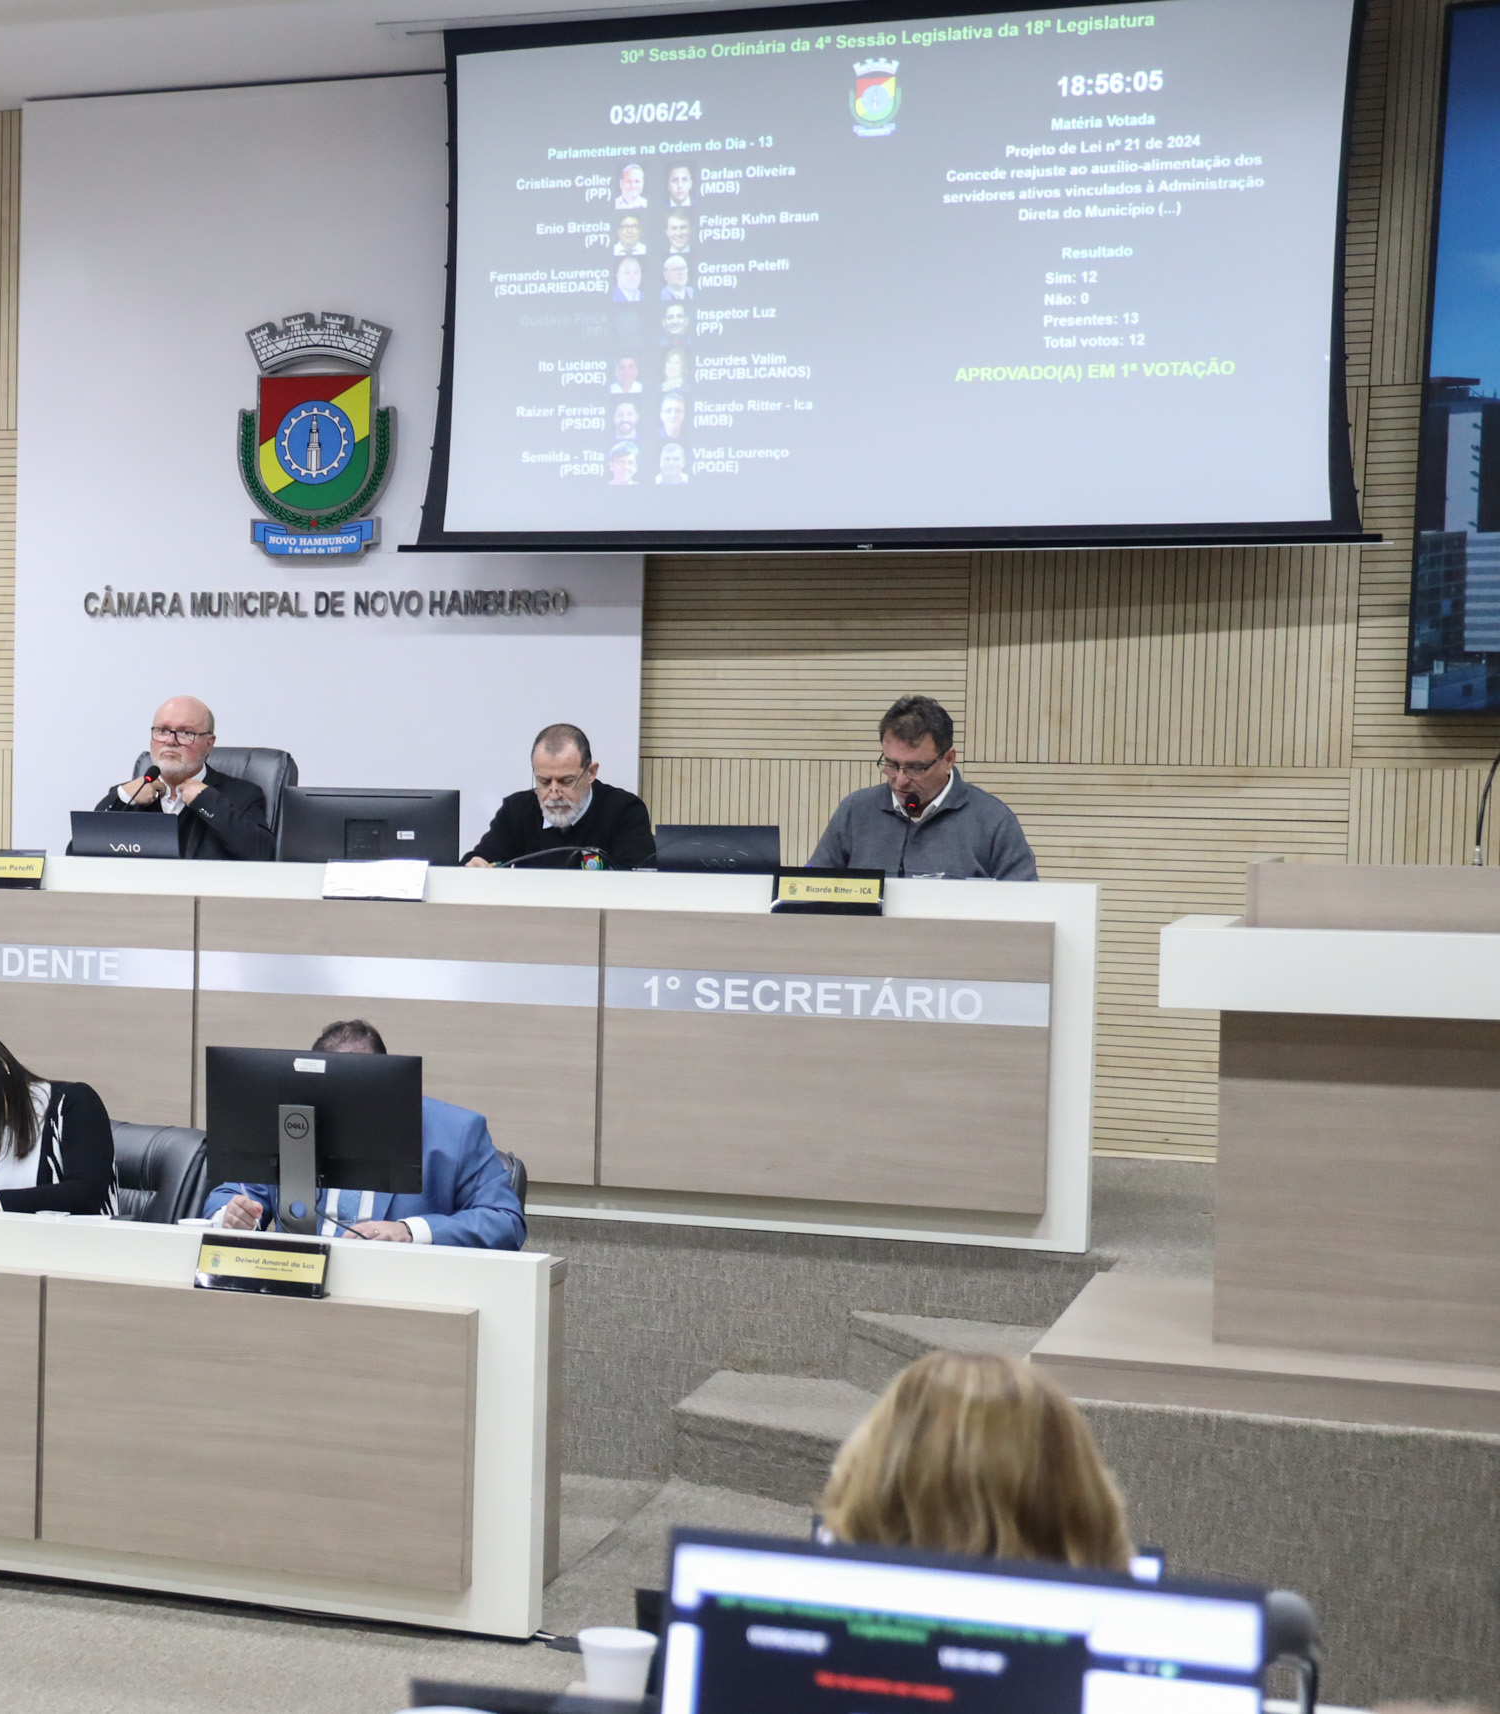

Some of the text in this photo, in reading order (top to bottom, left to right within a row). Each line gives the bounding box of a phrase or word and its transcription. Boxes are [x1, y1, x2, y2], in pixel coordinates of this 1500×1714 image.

[620, 15, 1155, 64] 30ª Sessão Ordinária da 4ª Sessão Legislativa da 18ª Legislatura
[1057, 70, 1164, 97] 18:56:05
[609, 100, 702, 125] 03/06/24
[1051, 113, 1155, 131] Matéria Votada
[548, 145, 636, 160] Parlamentares
[640, 144, 656, 155] na
[659, 140, 701, 155] Ordem
[705, 139, 722, 151] do
[725, 138, 746, 150] Dia
[758, 136, 773, 148] 13
[1005, 144, 1056, 159] Projeto
[1059, 142, 1077, 154] de
[1080, 141, 1102, 154] Lei
[1124, 138, 1140, 151] 21
[1145, 137, 1163, 150] de
[1167, 134, 1201, 149] 2024
[700, 164, 796, 181] Darlan Oliveira
[946, 153, 1263, 182] Concede reajuste ao auxílio-alimentação dos
[516, 174, 612, 190] Cristiano Coller
[700, 181, 740, 197] (MDB)
[585, 187, 612, 202] (PP)
[943, 176, 1265, 204] servidores ativos vinculados à Administração
[699, 211, 819, 228] Felipe Kuhn Braun
[1018, 207, 1060, 222] Direta
[1063, 206, 1082, 219] do
[1085, 202, 1155, 220] Município
[536, 221, 610, 235] Enio Brizola
[698, 228, 745, 243] (PSDB)
[585, 234, 610, 248] (PT)
[1062, 245, 1133, 260] Resultado
[698, 259, 789, 274] Gerson Peteffi
[489, 269, 609, 283] Fernando Lourenço
[697, 275, 737, 291] (MDB)
[1045, 270, 1098, 286] Sim: 12
[494, 280, 609, 299] (SOLIDARIEDADE)
[1044, 292, 1090, 306] Não: 0
[696, 306, 777, 321] Inspetor Luz
[1043, 312, 1140, 328] Presentes: 13
[696, 322, 723, 336] (PP)
[1043, 333, 1146, 349] Total votos: 12
[538, 359, 607, 372] Ito Luciano
[695, 353, 787, 367] Lourdes Valim
[694, 365, 811, 383] (REPUBLICANOS)
[955, 357, 1236, 383] APROVADO(A) EM 1ª VOTAÇÃO
[561, 371, 606, 387] (PODE)
[516, 404, 605, 418] Raizer Ferreira
[694, 401, 744, 413] Ricardo
[747, 400, 782, 411] Ritter
[794, 398, 813, 410] Ica
[560, 417, 605, 432] (PSDB)
[693, 414, 733, 429] (MDB)
[521, 450, 571, 463] Semilda
[582, 449, 605, 462] Tita
[692, 447, 790, 461] Vladi Lourenço
[559, 463, 604, 478] (PSDB)
[692, 460, 739, 475] (PODE)
[268, 535, 357, 546] NOVO HAMBURGO
[327, 546, 342, 554] 1927
[84, 585, 572, 619] CÂMARA MUNICIPAL DE NOVO HAMBURGO
[109, 842, 141, 853] VAIO
[9, 864, 35, 872] Peteffi
[806, 885, 832, 894] Ricardo
[834, 886, 853, 894] Ritter
[860, 887, 872, 895] ICA
[643, 975, 984, 1022] 1º SECRETÁRIO
[262, 1258, 289, 1267] Amaral
[291, 1260, 300, 1268] da
[303, 1261, 314, 1270] Luz
